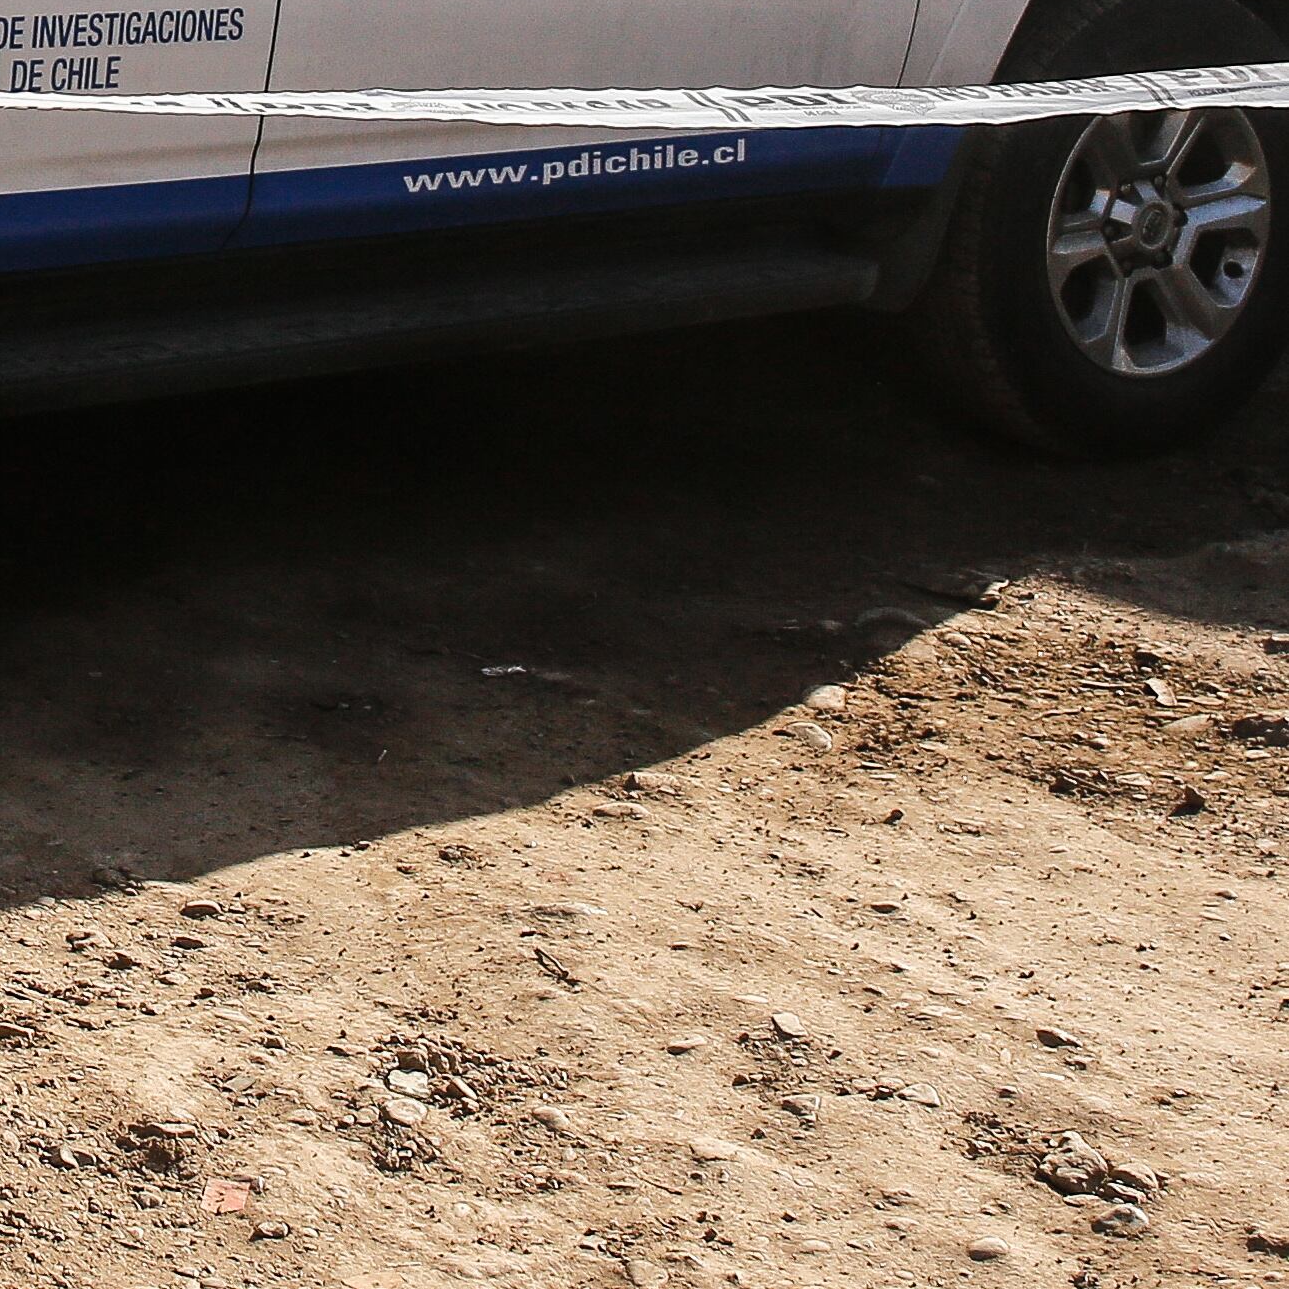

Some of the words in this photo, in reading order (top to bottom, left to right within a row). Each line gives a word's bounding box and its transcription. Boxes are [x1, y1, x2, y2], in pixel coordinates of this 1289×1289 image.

[32, 8, 244, 49] INVESTIGACIONES
[10, 59, 44, 92] DE
[51, 56, 121, 90] CHILE
[403, 138, 745, 192] www.pdichile.cl
